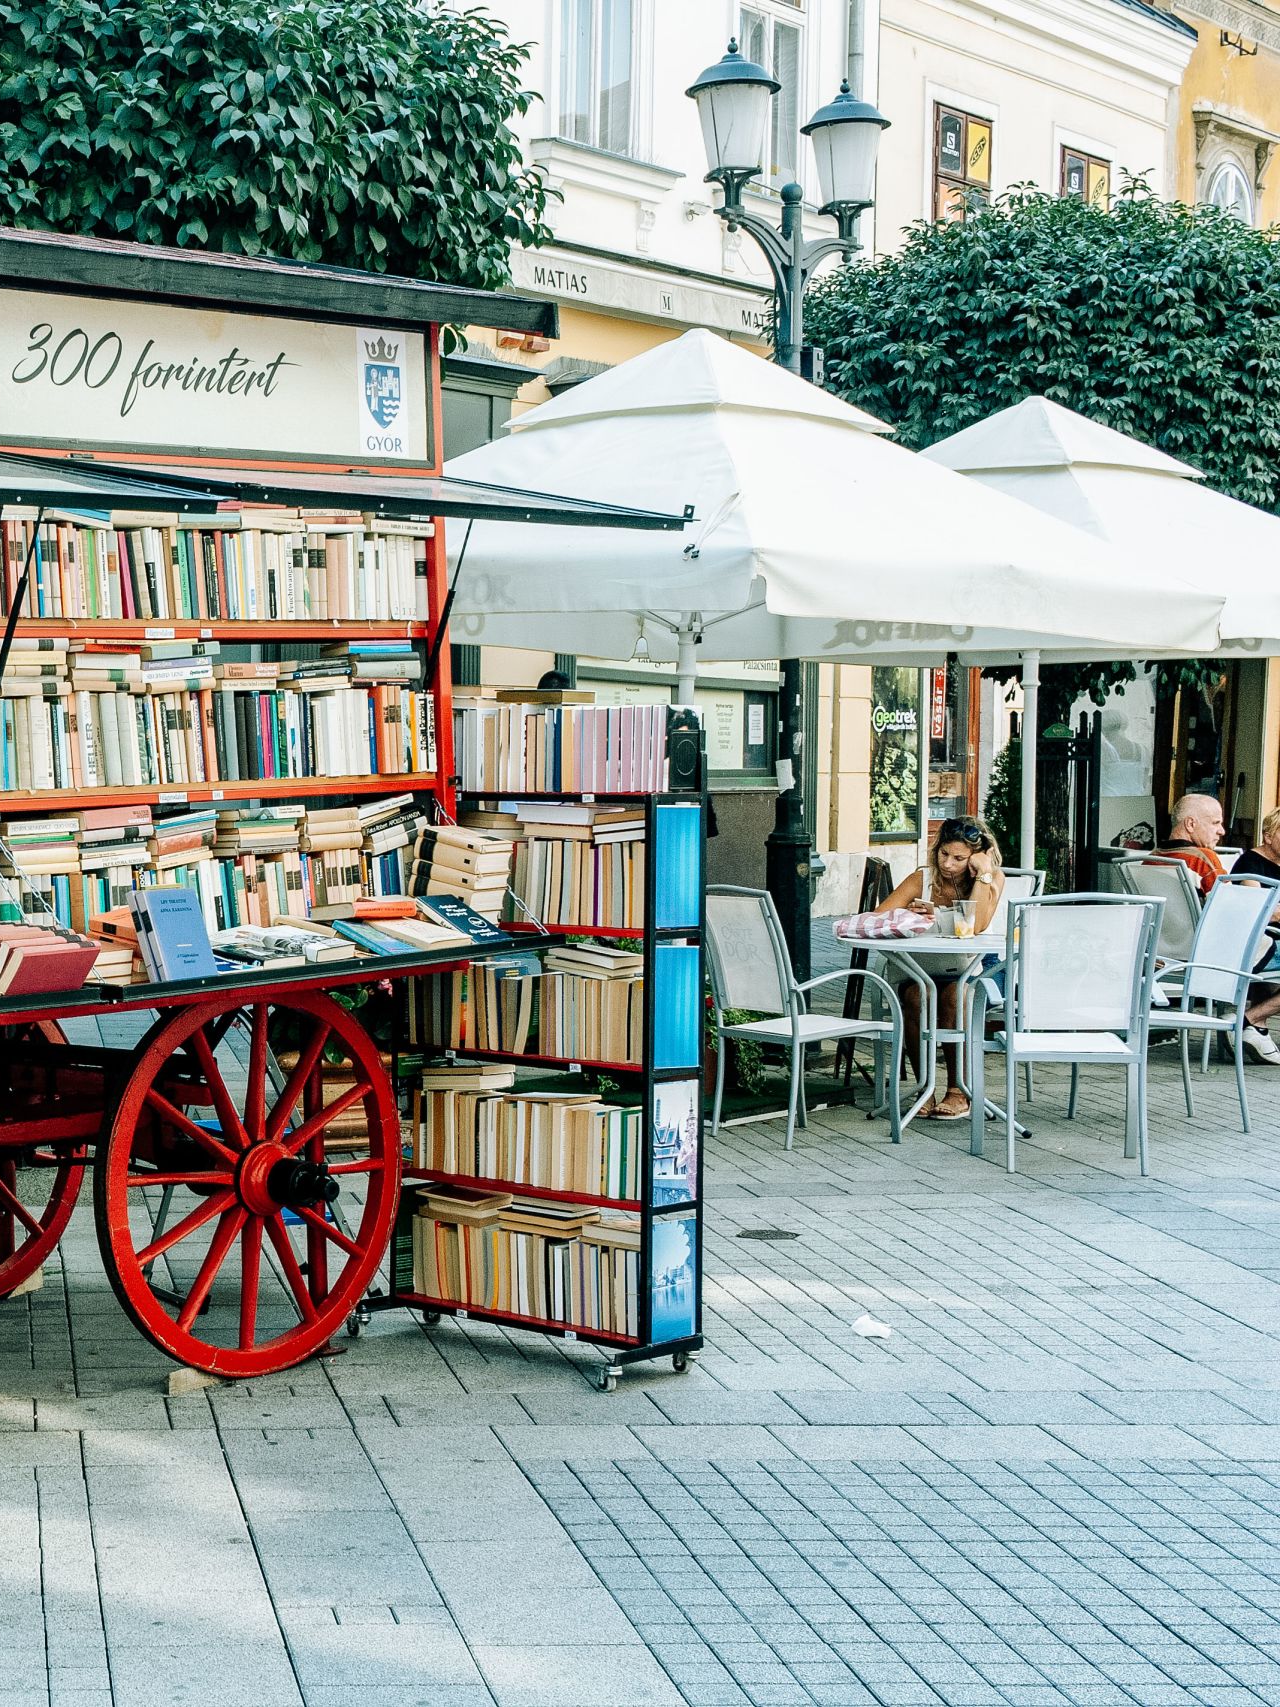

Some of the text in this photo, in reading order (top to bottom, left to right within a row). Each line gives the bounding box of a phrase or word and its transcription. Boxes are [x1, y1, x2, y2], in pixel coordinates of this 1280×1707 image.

[534, 266, 587, 294] MATIAS
[11, 322, 302, 417] 300 forintért
[286, 561, 294, 613] Feuchtwanger
[743, 660, 778, 672] Palacsinta
[875, 706, 917, 727] geotrek
[86, 723, 95, 774] HELLER
